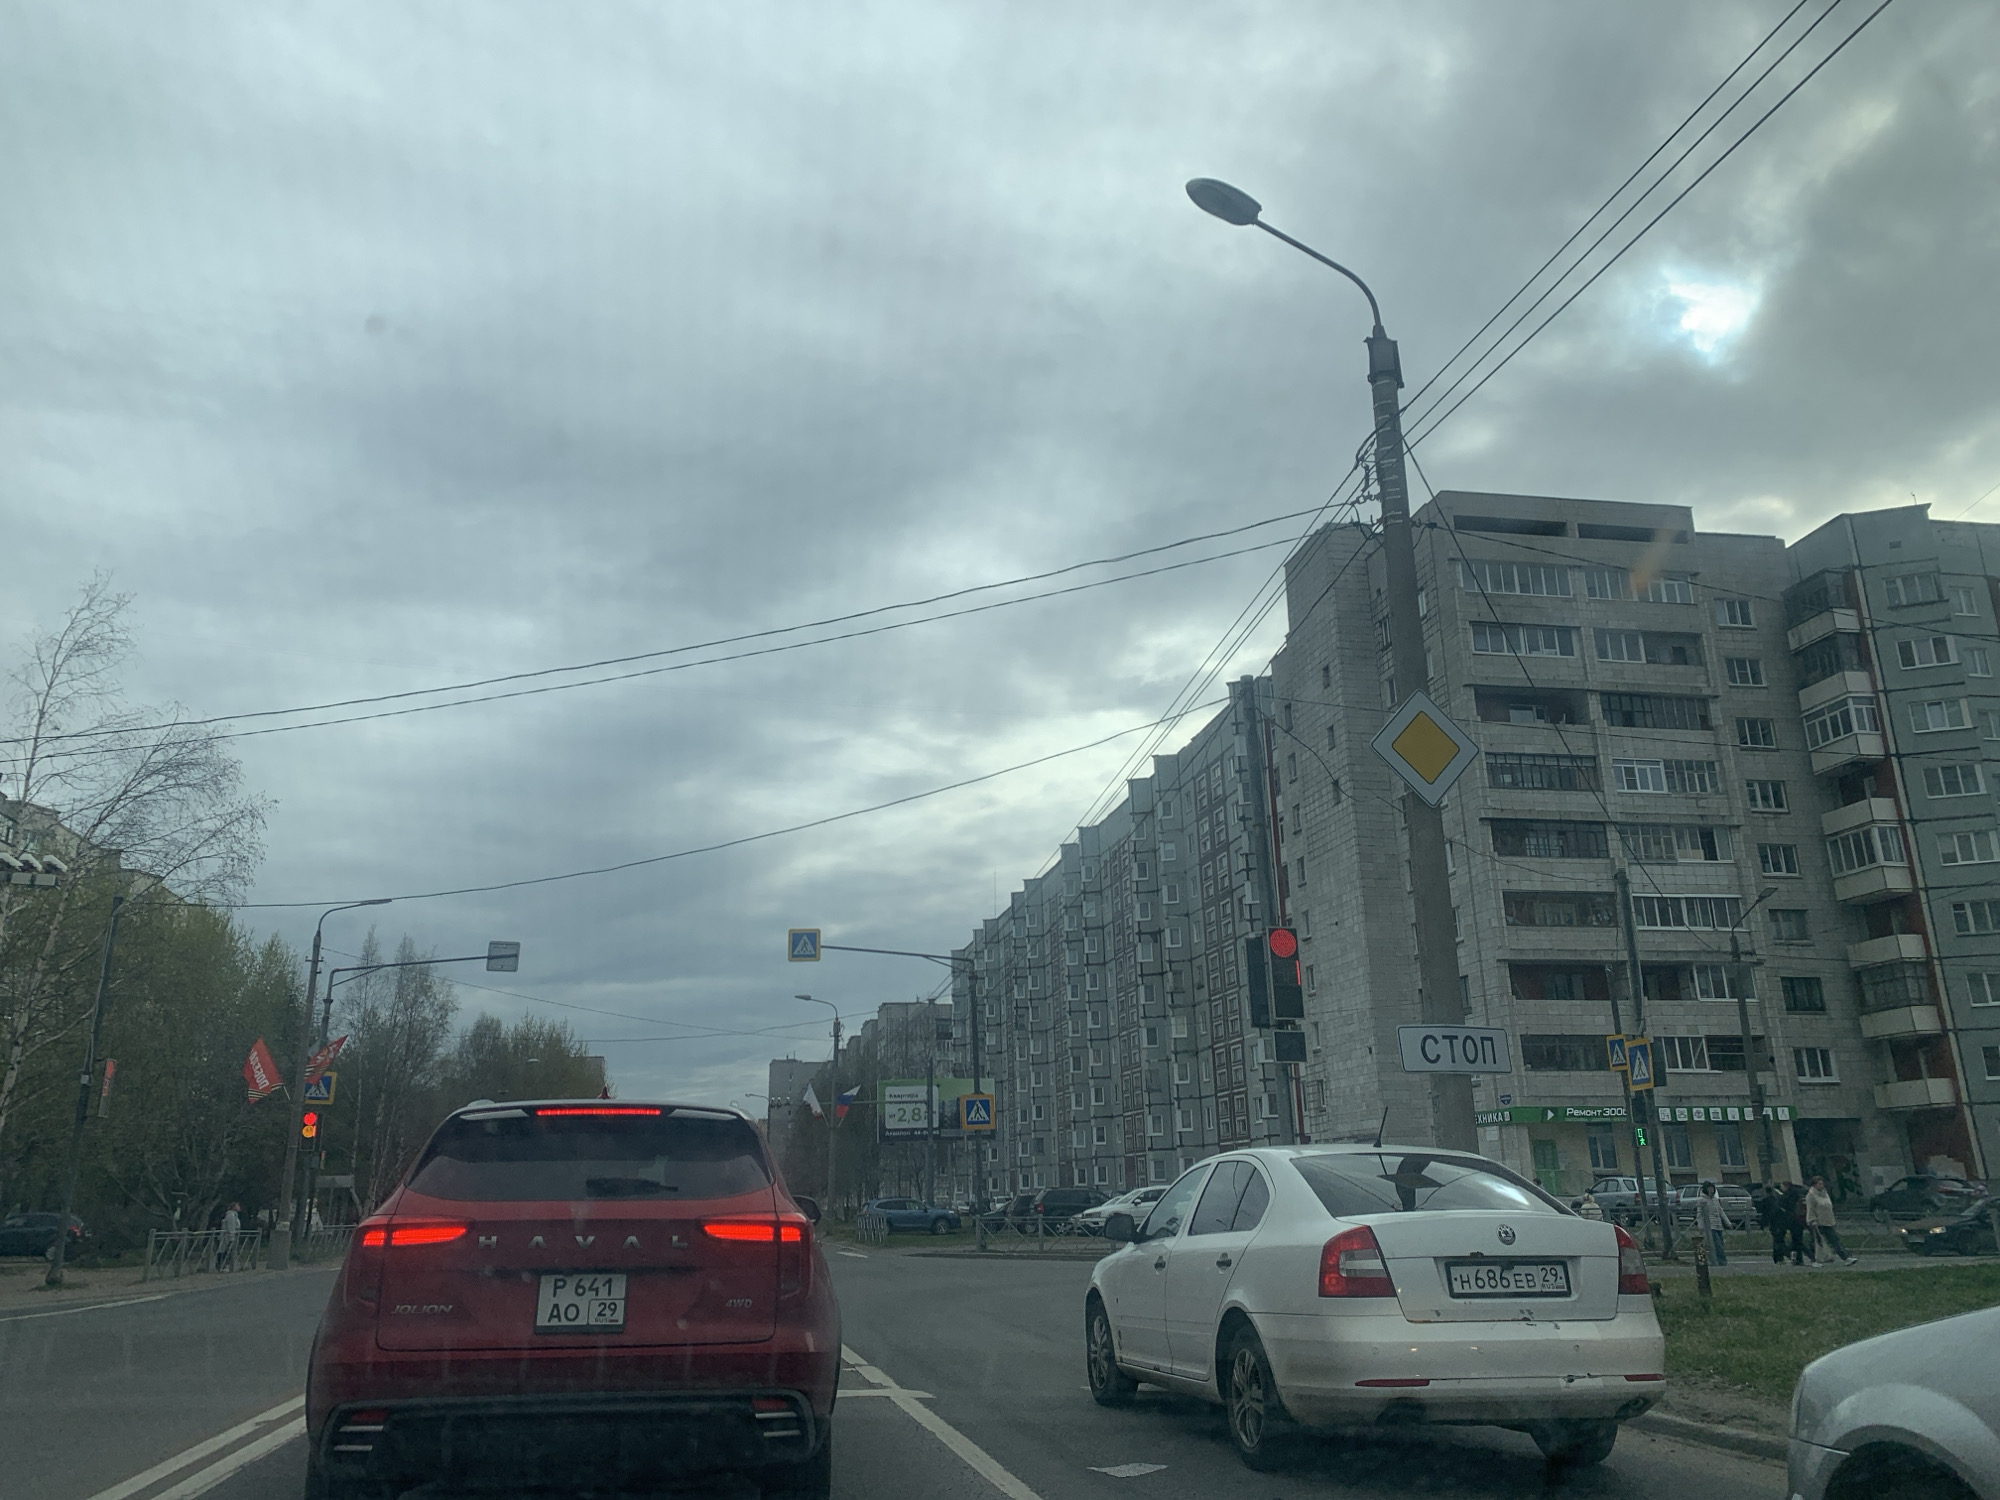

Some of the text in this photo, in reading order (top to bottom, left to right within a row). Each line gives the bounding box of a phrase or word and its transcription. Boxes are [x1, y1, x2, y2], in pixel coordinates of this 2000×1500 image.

[1421, 1034, 1497, 1064] СТОП
[897, 1107, 922, 1124] 2,8
[1566, 1107, 1602, 1116] Ремонт
[478, 1235, 688, 1249] HAVAL
[1540, 1267, 1558, 1283] 29
[391, 1304, 453, 1314] JOLION
[725, 1299, 752, 1308] 4WD
[547, 1302, 617, 1323] АО 29
